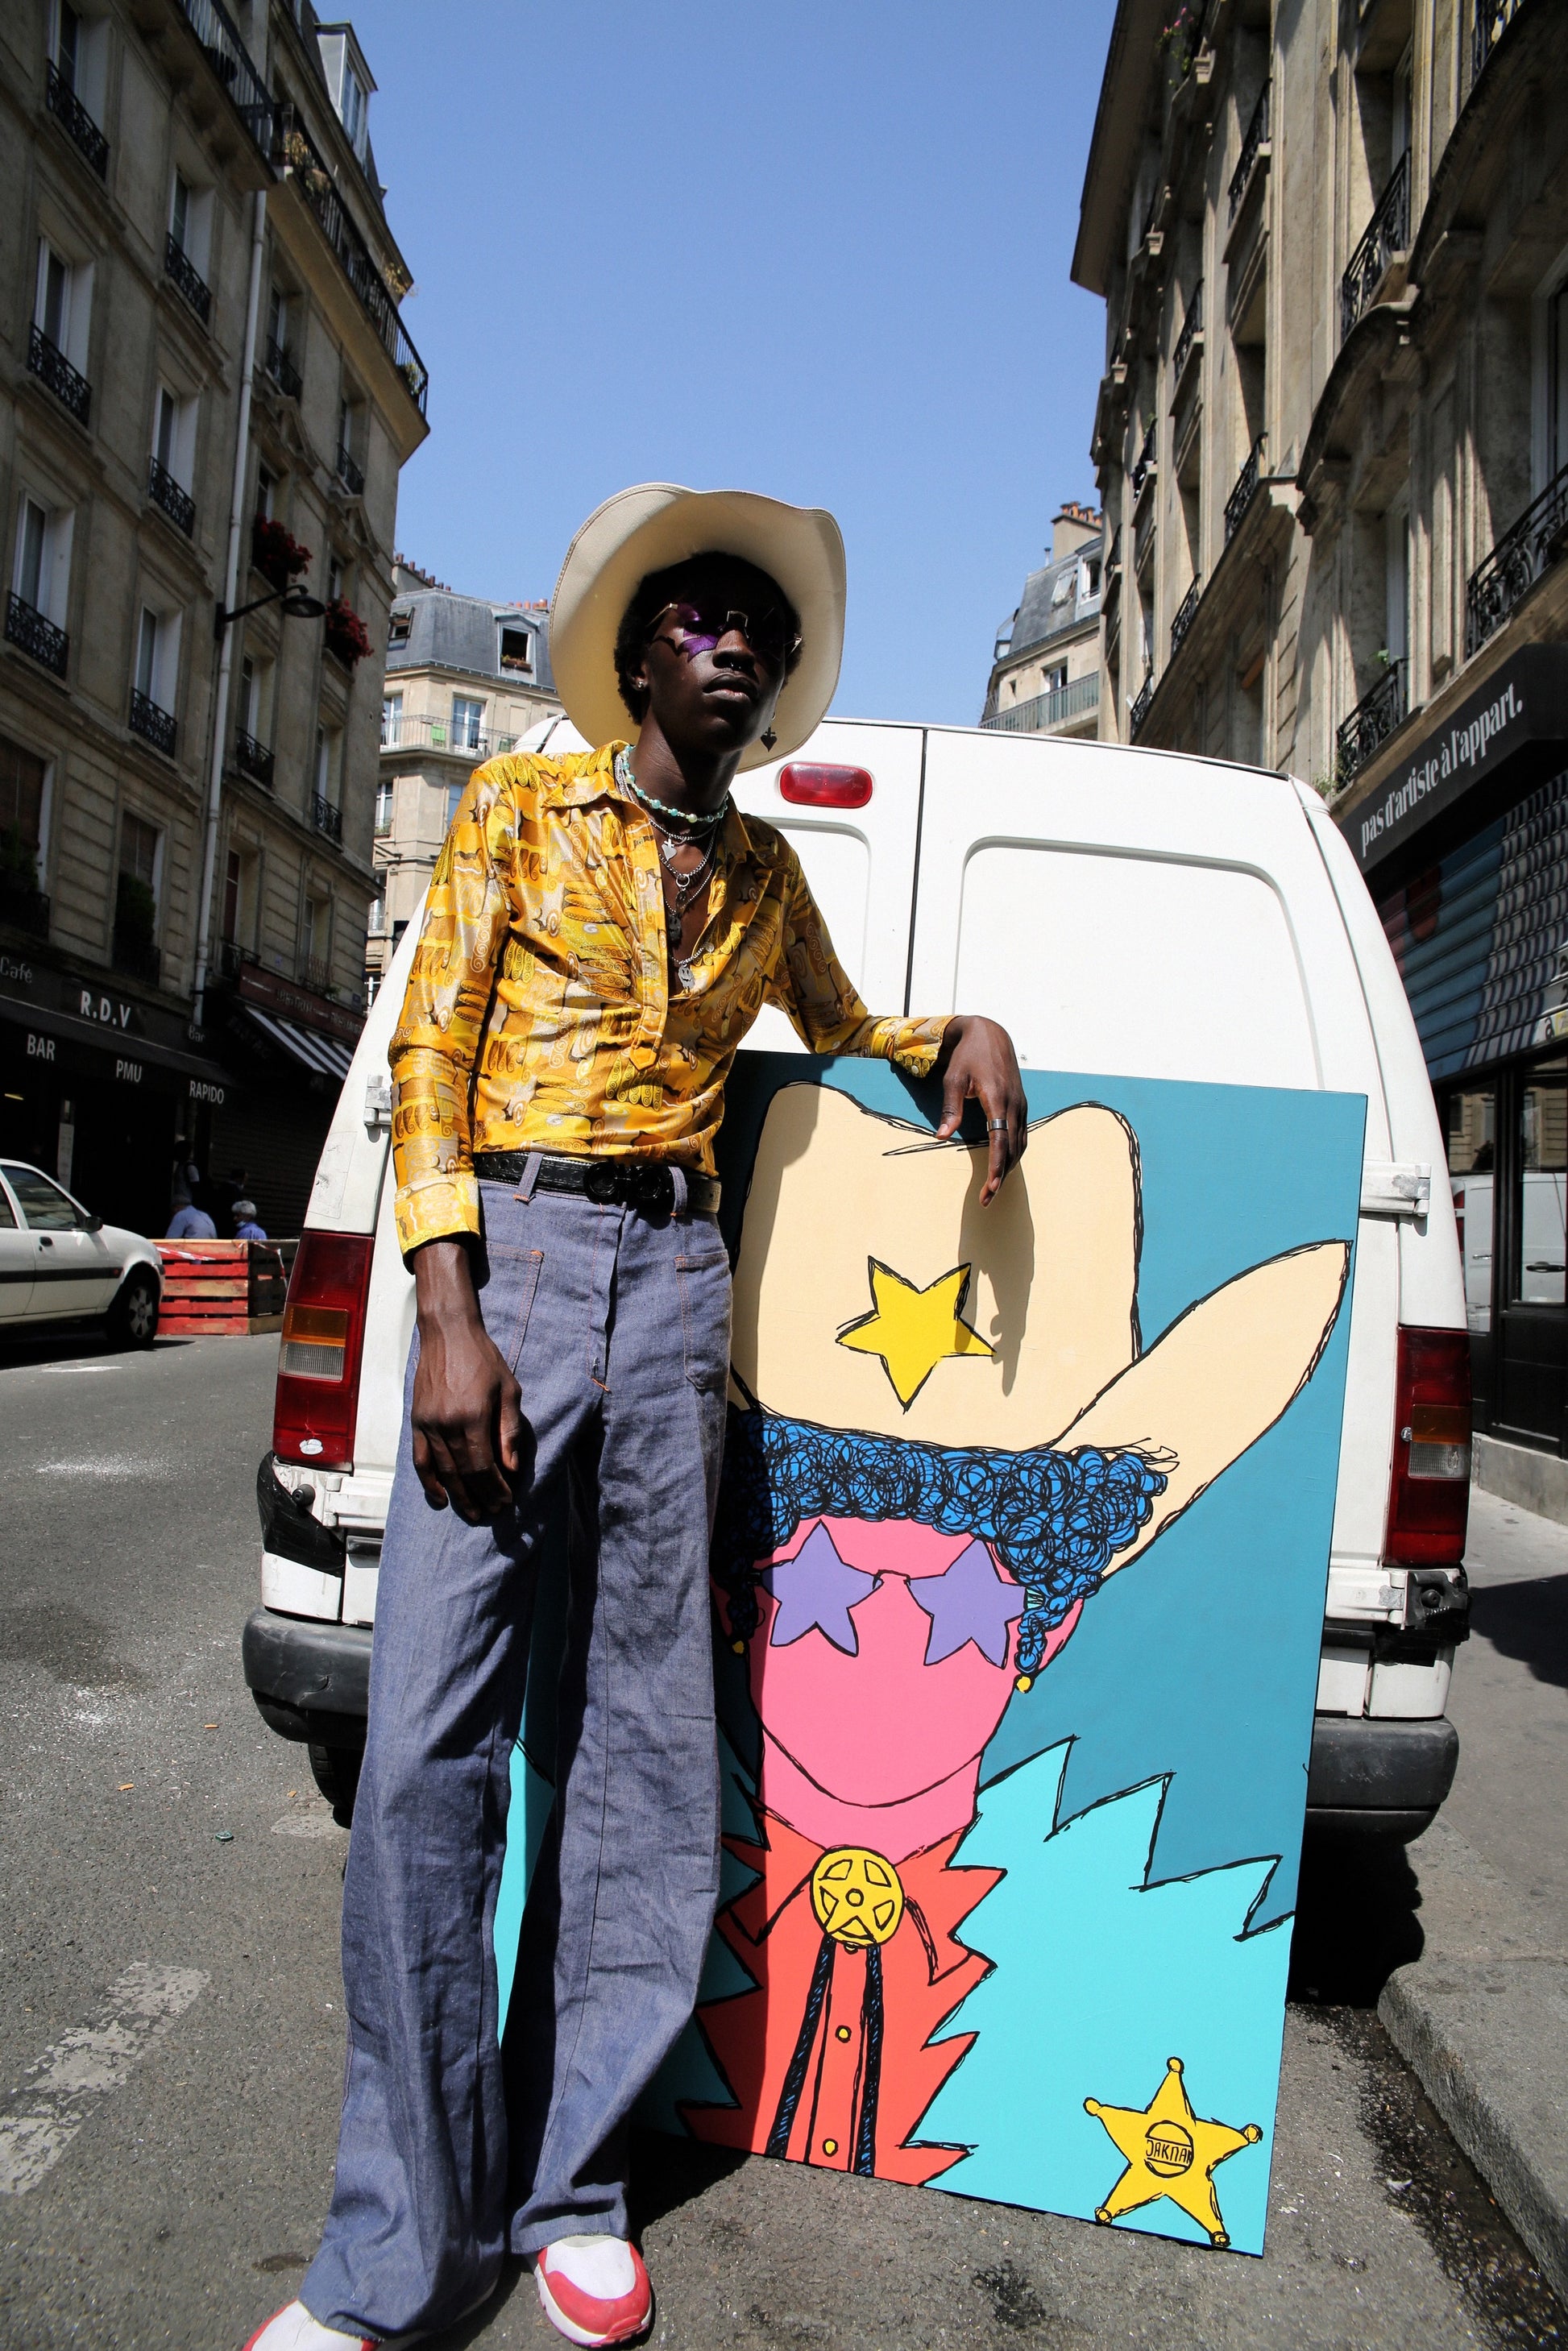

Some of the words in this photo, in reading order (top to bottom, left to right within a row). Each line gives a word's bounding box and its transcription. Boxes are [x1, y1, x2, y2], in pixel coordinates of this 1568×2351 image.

[1362, 808, 1384, 857] pas
[1385, 758, 1439, 827] d'artiste
[1441, 742, 1451, 779] à
[1451, 682, 1523, 771] l'appart.
[0, 956, 33, 984] Café
[80, 989, 131, 1029] R.D.V
[188, 1024, 206, 1045] Bar
[26, 1032, 56, 1062] BAR
[115, 1058, 143, 1084] PMU
[189, 1080, 225, 1105] RAPIDO
